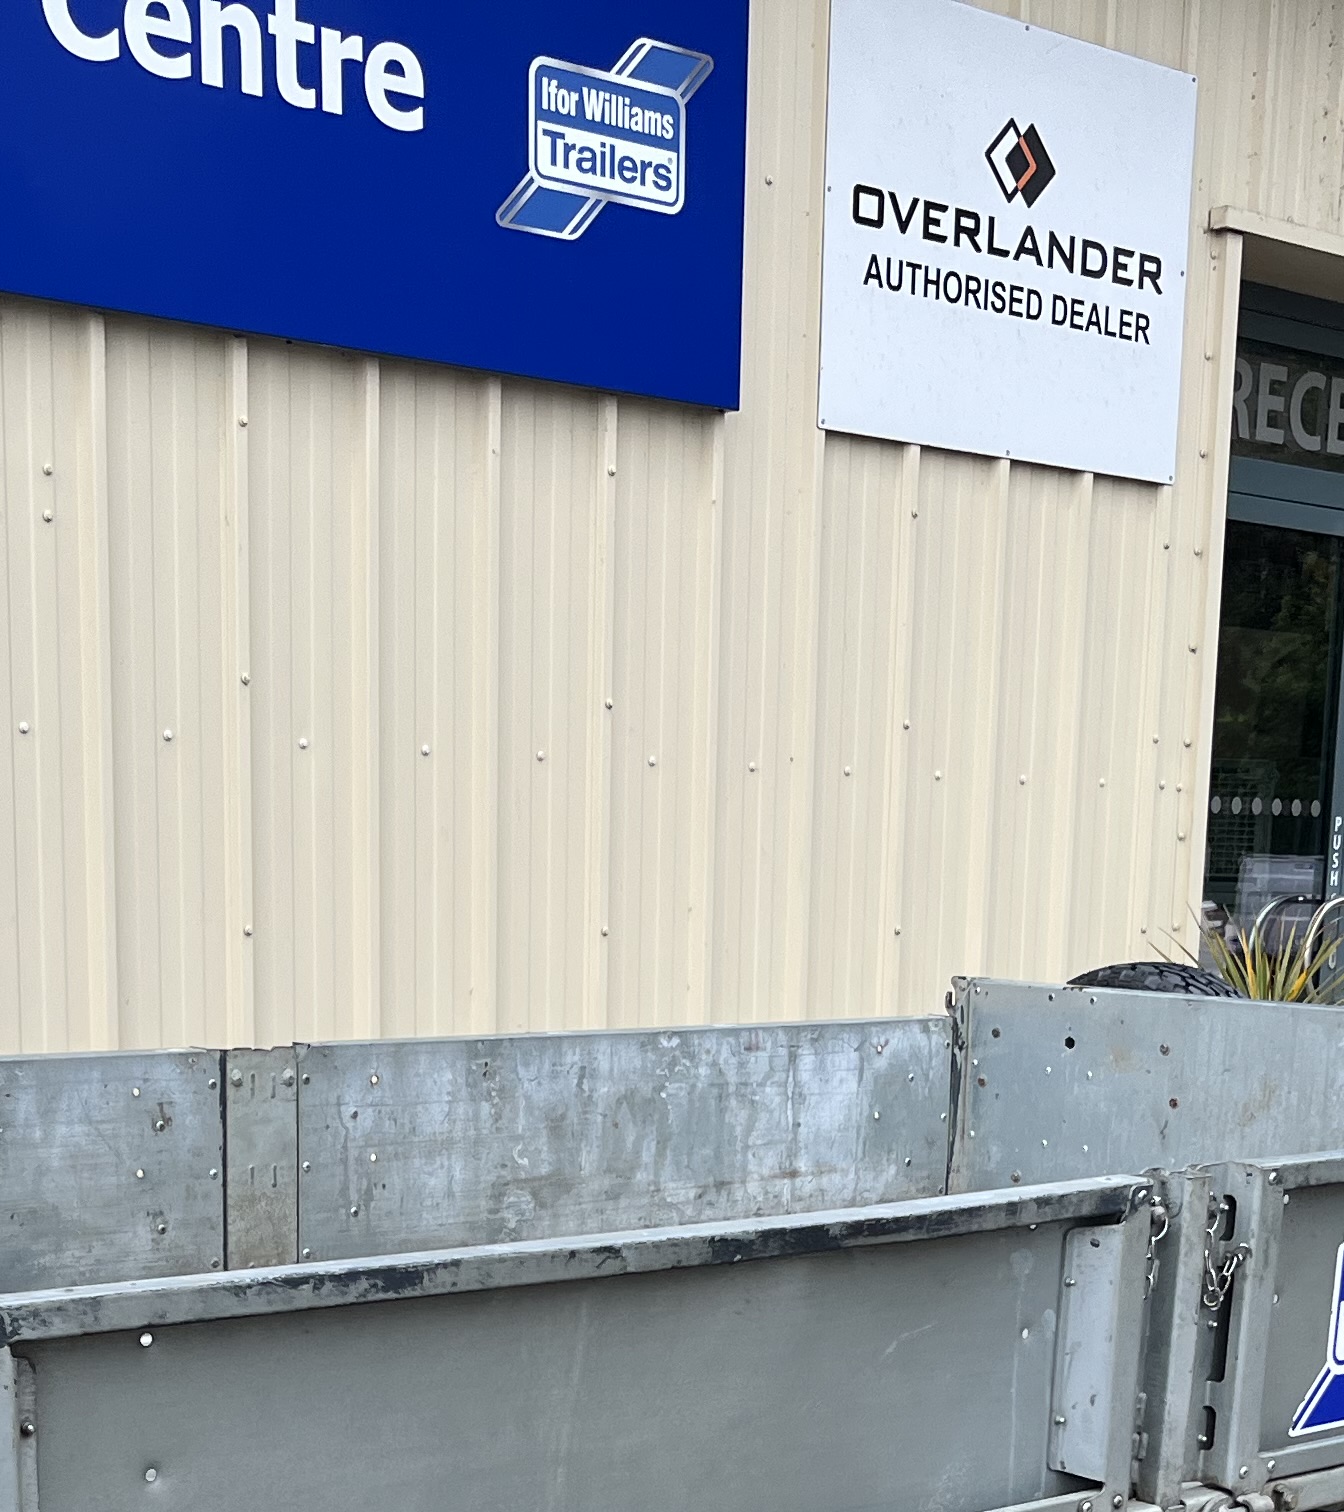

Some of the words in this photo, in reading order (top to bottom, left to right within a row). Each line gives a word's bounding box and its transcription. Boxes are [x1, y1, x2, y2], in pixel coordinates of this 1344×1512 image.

[540, 76, 580, 117] Ifor
[581, 86, 674, 140] Williams
[541, 128, 673, 192] Trailers
[852, 183, 1163, 295] OVERLANDER
[863, 253, 1043, 321] AUTHORISED
[1051, 293, 1151, 345] DEALER
[1329, 816, 1343, 887] PUSH
